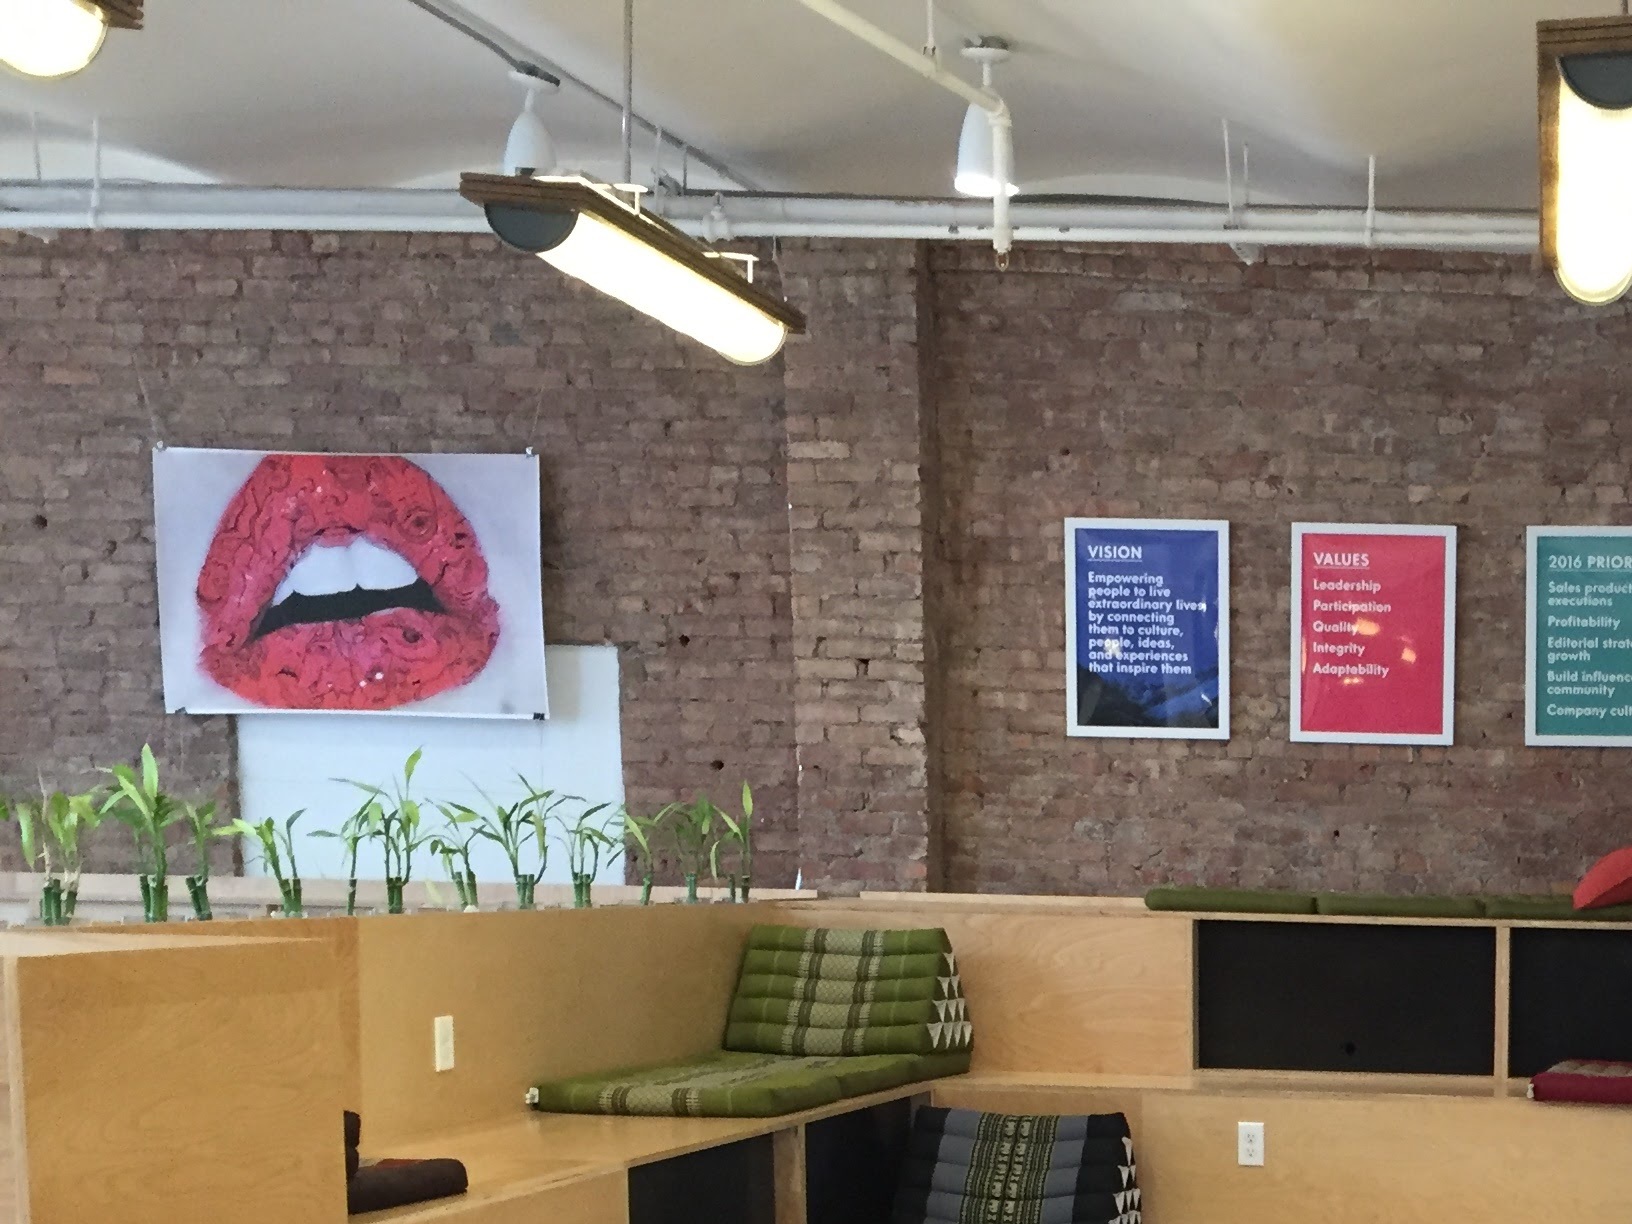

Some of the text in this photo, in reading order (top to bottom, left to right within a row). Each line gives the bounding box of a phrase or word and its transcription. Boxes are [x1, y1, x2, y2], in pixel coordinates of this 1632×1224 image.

[1087, 545, 1142, 559] VISION
[1313, 552, 1370, 566] VALUES
[1548, 554, 1582, 568] 2016
[1087, 571, 1163, 586] Empowering
[1313, 578, 1381, 593] Leadership
[1088, 585, 1170, 599] people to live
[1548, 581, 1580, 593] Sales
[1087, 599, 1172, 612] extraordinary
[1312, 599, 1391, 614] Participation
[1547, 595, 1612, 606] executions
[1088, 611, 1174, 625] by connecting
[1547, 615, 1620, 630] Profitability
[1088, 624, 1184, 637] them to culture,
[1312, 620, 1358, 636] Quality
[1088, 637, 1174, 649] people, ideas,
[1312, 641, 1365, 657] Integrity
[1547, 637, 1598, 648] Editorial
[1088, 649, 1188, 663] and experiences
[1547, 649, 1590, 663] growth
[1088, 662, 1192, 676] that inspire them
[1312, 663, 1389, 678] Adaptability
[1547, 670, 1578, 682] Build
[1546, 683, 1615, 697] community
[1546, 704, 1606, 718] Company
